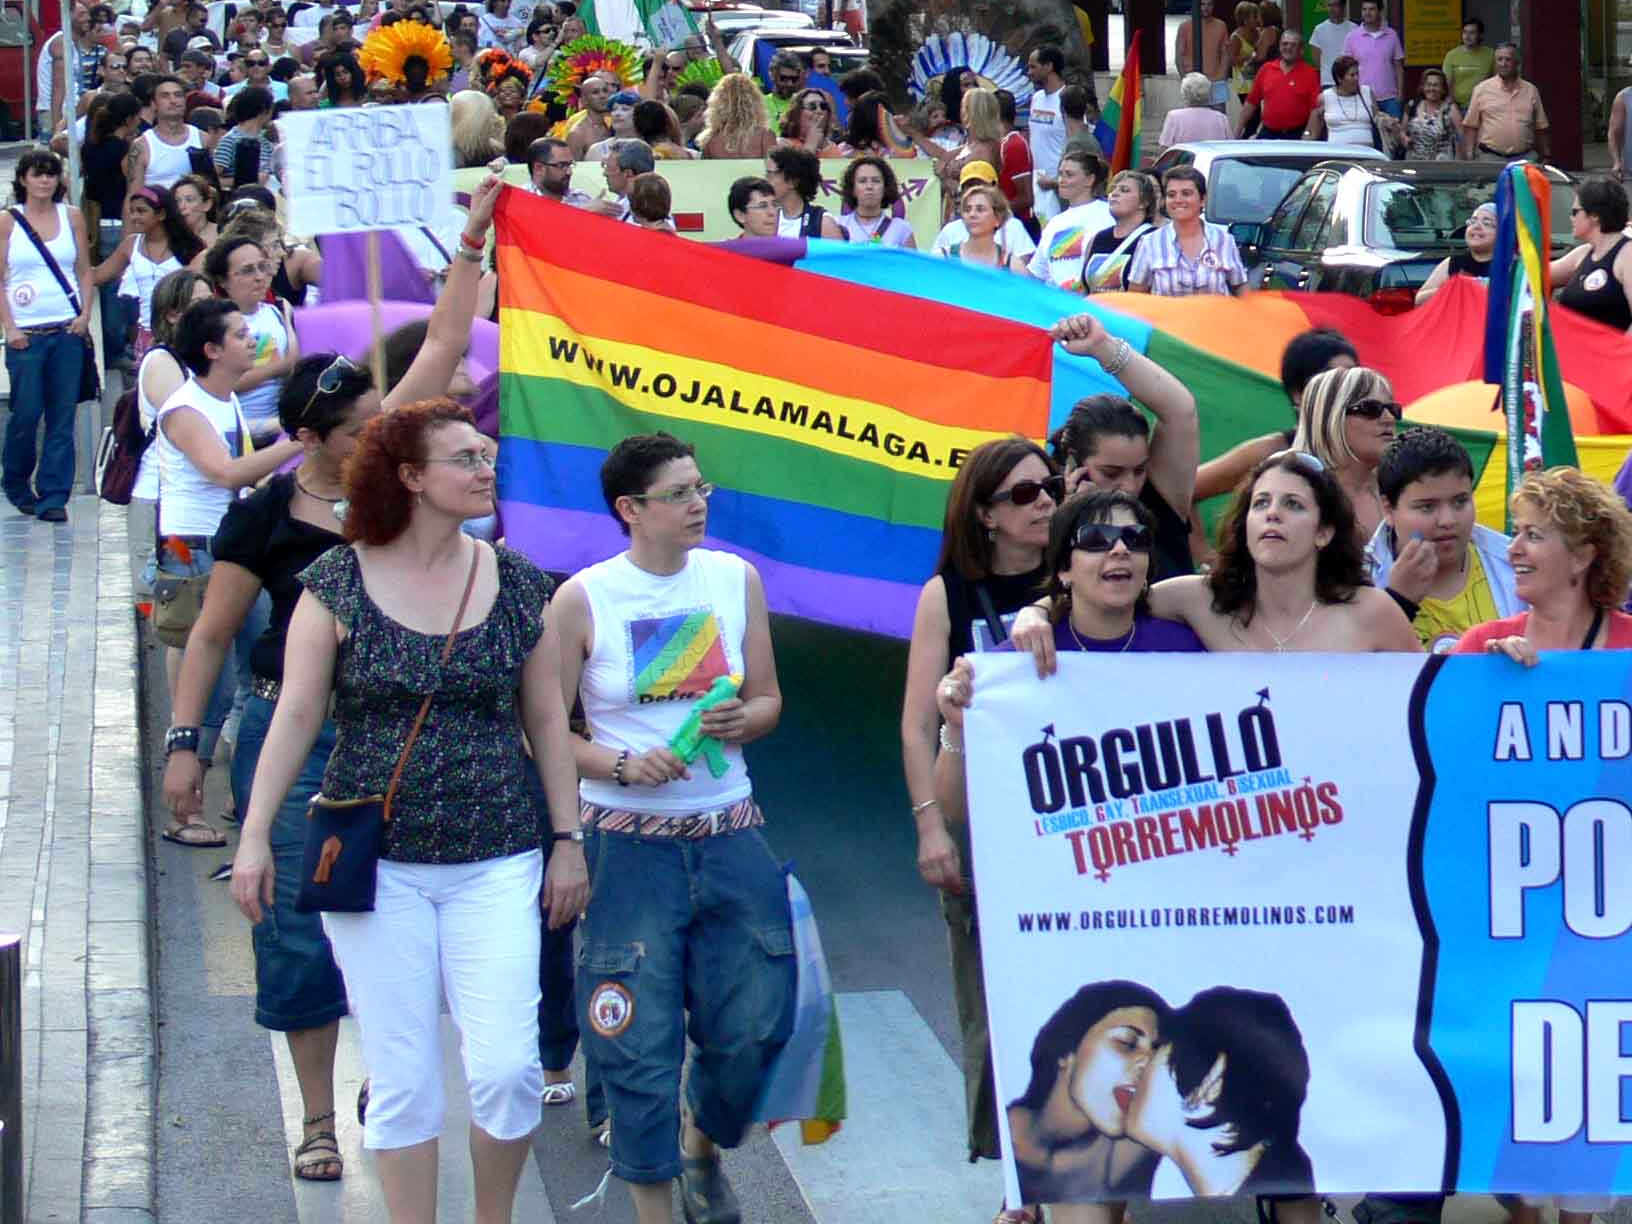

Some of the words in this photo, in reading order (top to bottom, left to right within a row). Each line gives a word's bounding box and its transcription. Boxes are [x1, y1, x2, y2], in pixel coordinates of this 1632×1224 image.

[304, 109, 426, 152] ARRIBA
[303, 154, 358, 195] EL
[335, 183, 436, 228] BOLLO
[548, 336, 974, 471] WWW.OJALAMALAGA.E
[1023, 687, 1282, 815] ORGULLO
[1065, 778, 1345, 882] TORREMOLINOS
[1018, 905, 1355, 933] WWW.ORGULLOTORREMOLINOS.COM
